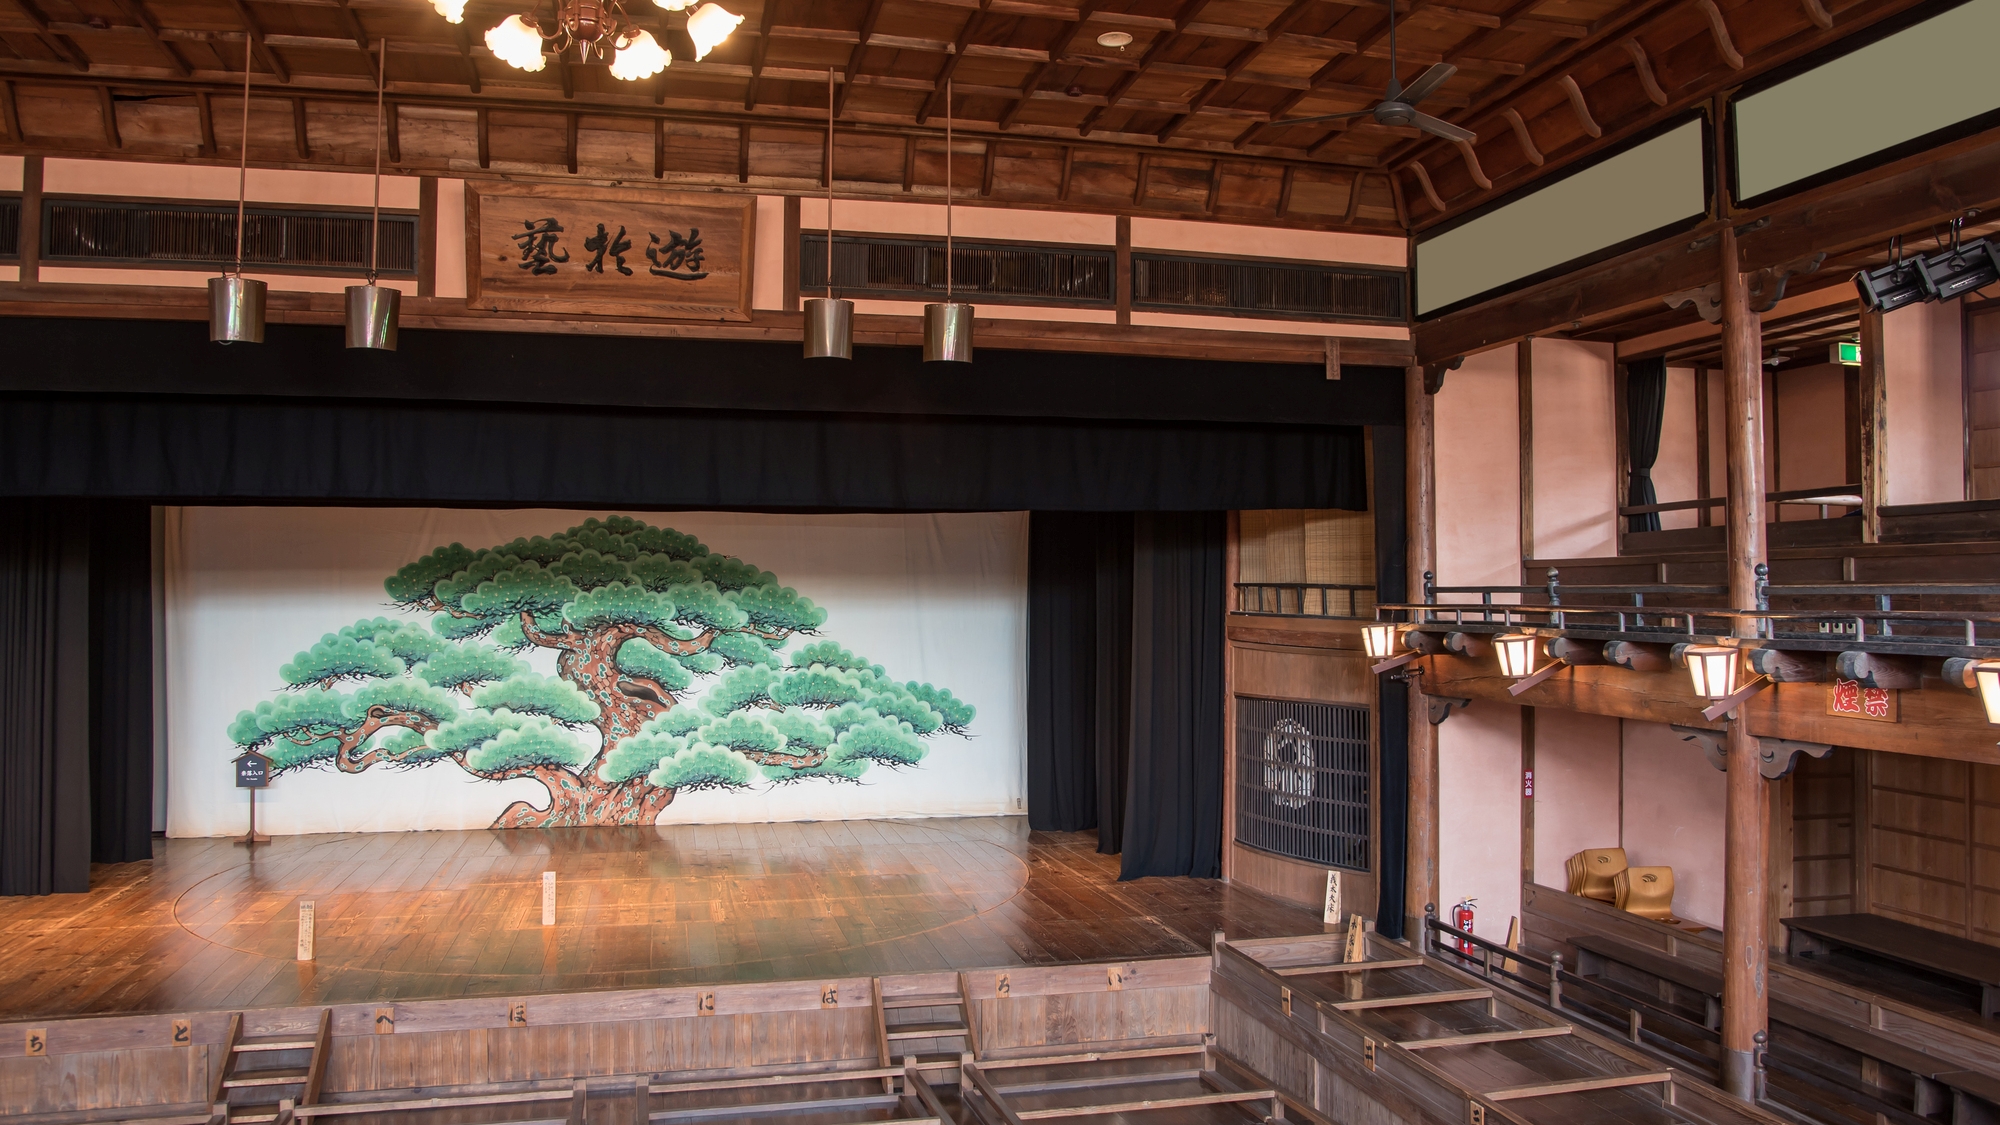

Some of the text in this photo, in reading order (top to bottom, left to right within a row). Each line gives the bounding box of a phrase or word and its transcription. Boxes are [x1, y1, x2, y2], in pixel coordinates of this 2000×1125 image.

[699, 994, 714, 1010] に
[822, 988, 837, 1004] は
[174, 1025, 189, 1042] と
[30, 1035, 43, 1052] ち
